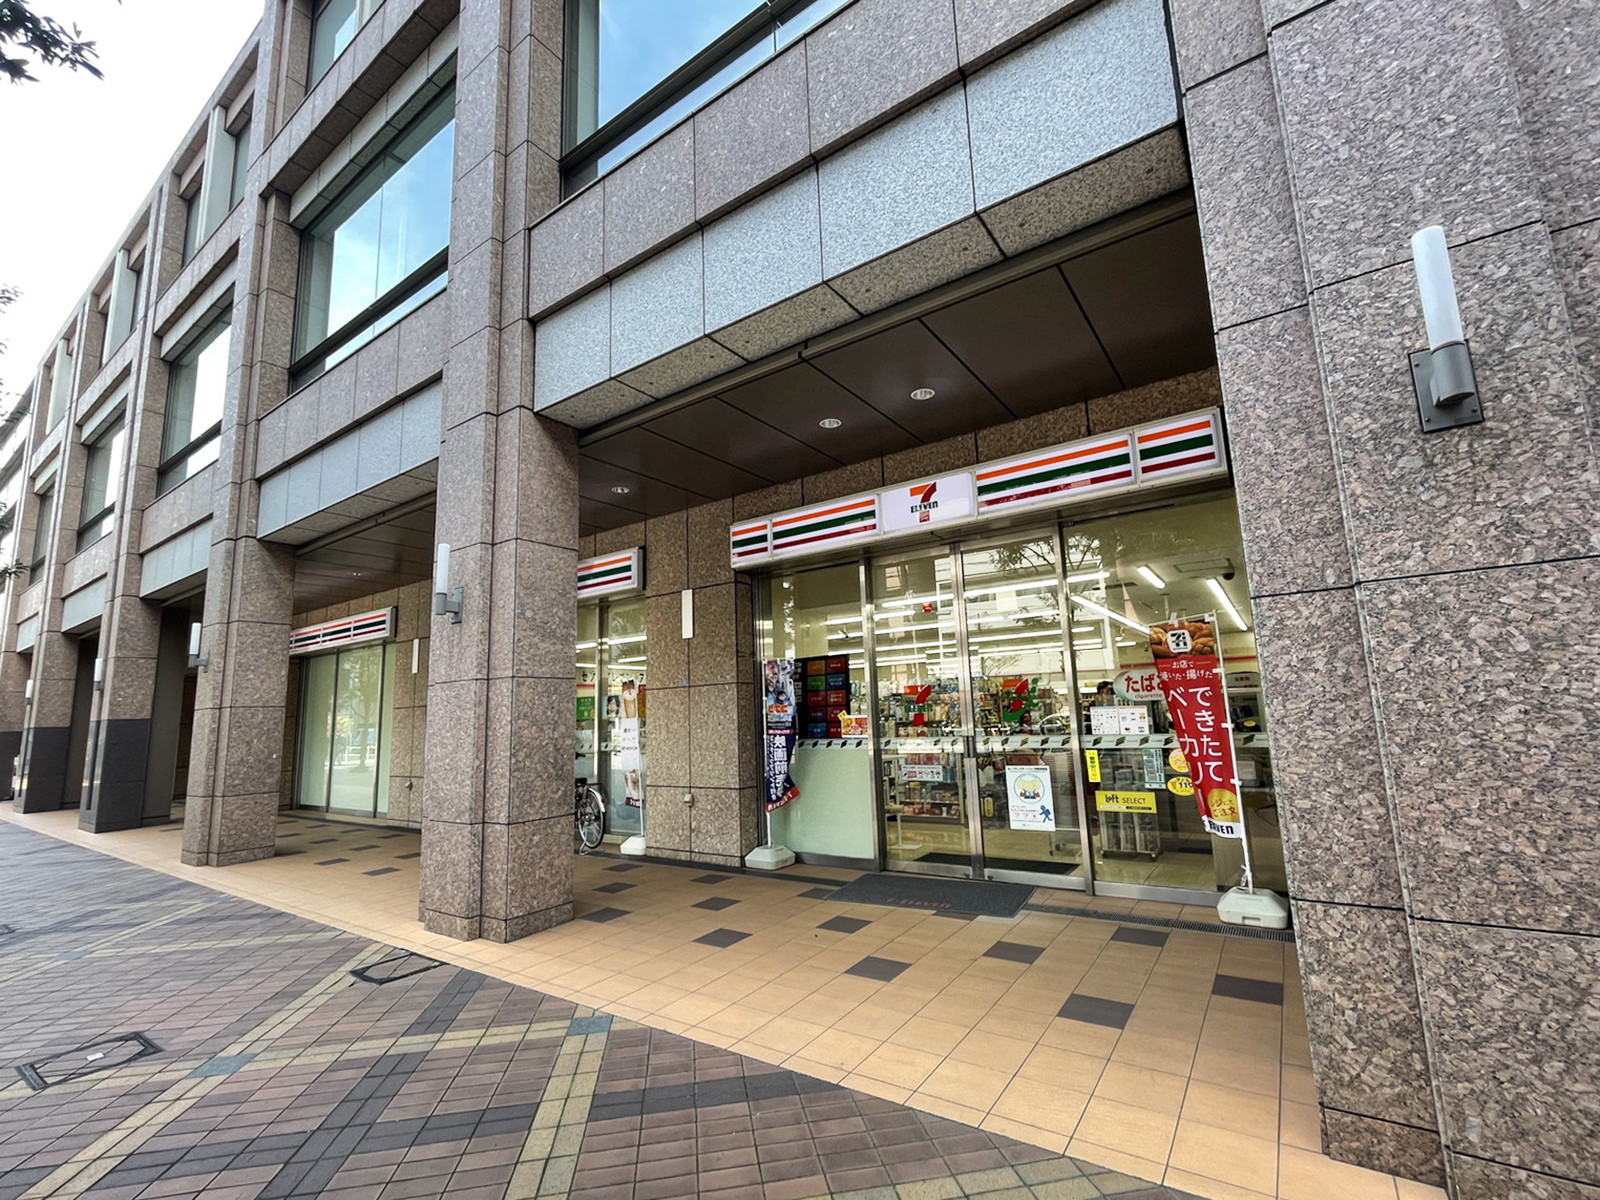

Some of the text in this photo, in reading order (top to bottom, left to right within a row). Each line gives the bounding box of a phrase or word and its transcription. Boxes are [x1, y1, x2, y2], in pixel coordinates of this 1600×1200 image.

[910, 482, 937, 503] 7
[1168, 686, 1205, 811] ベーカリー
[1188, 687, 1223, 782] できたて
